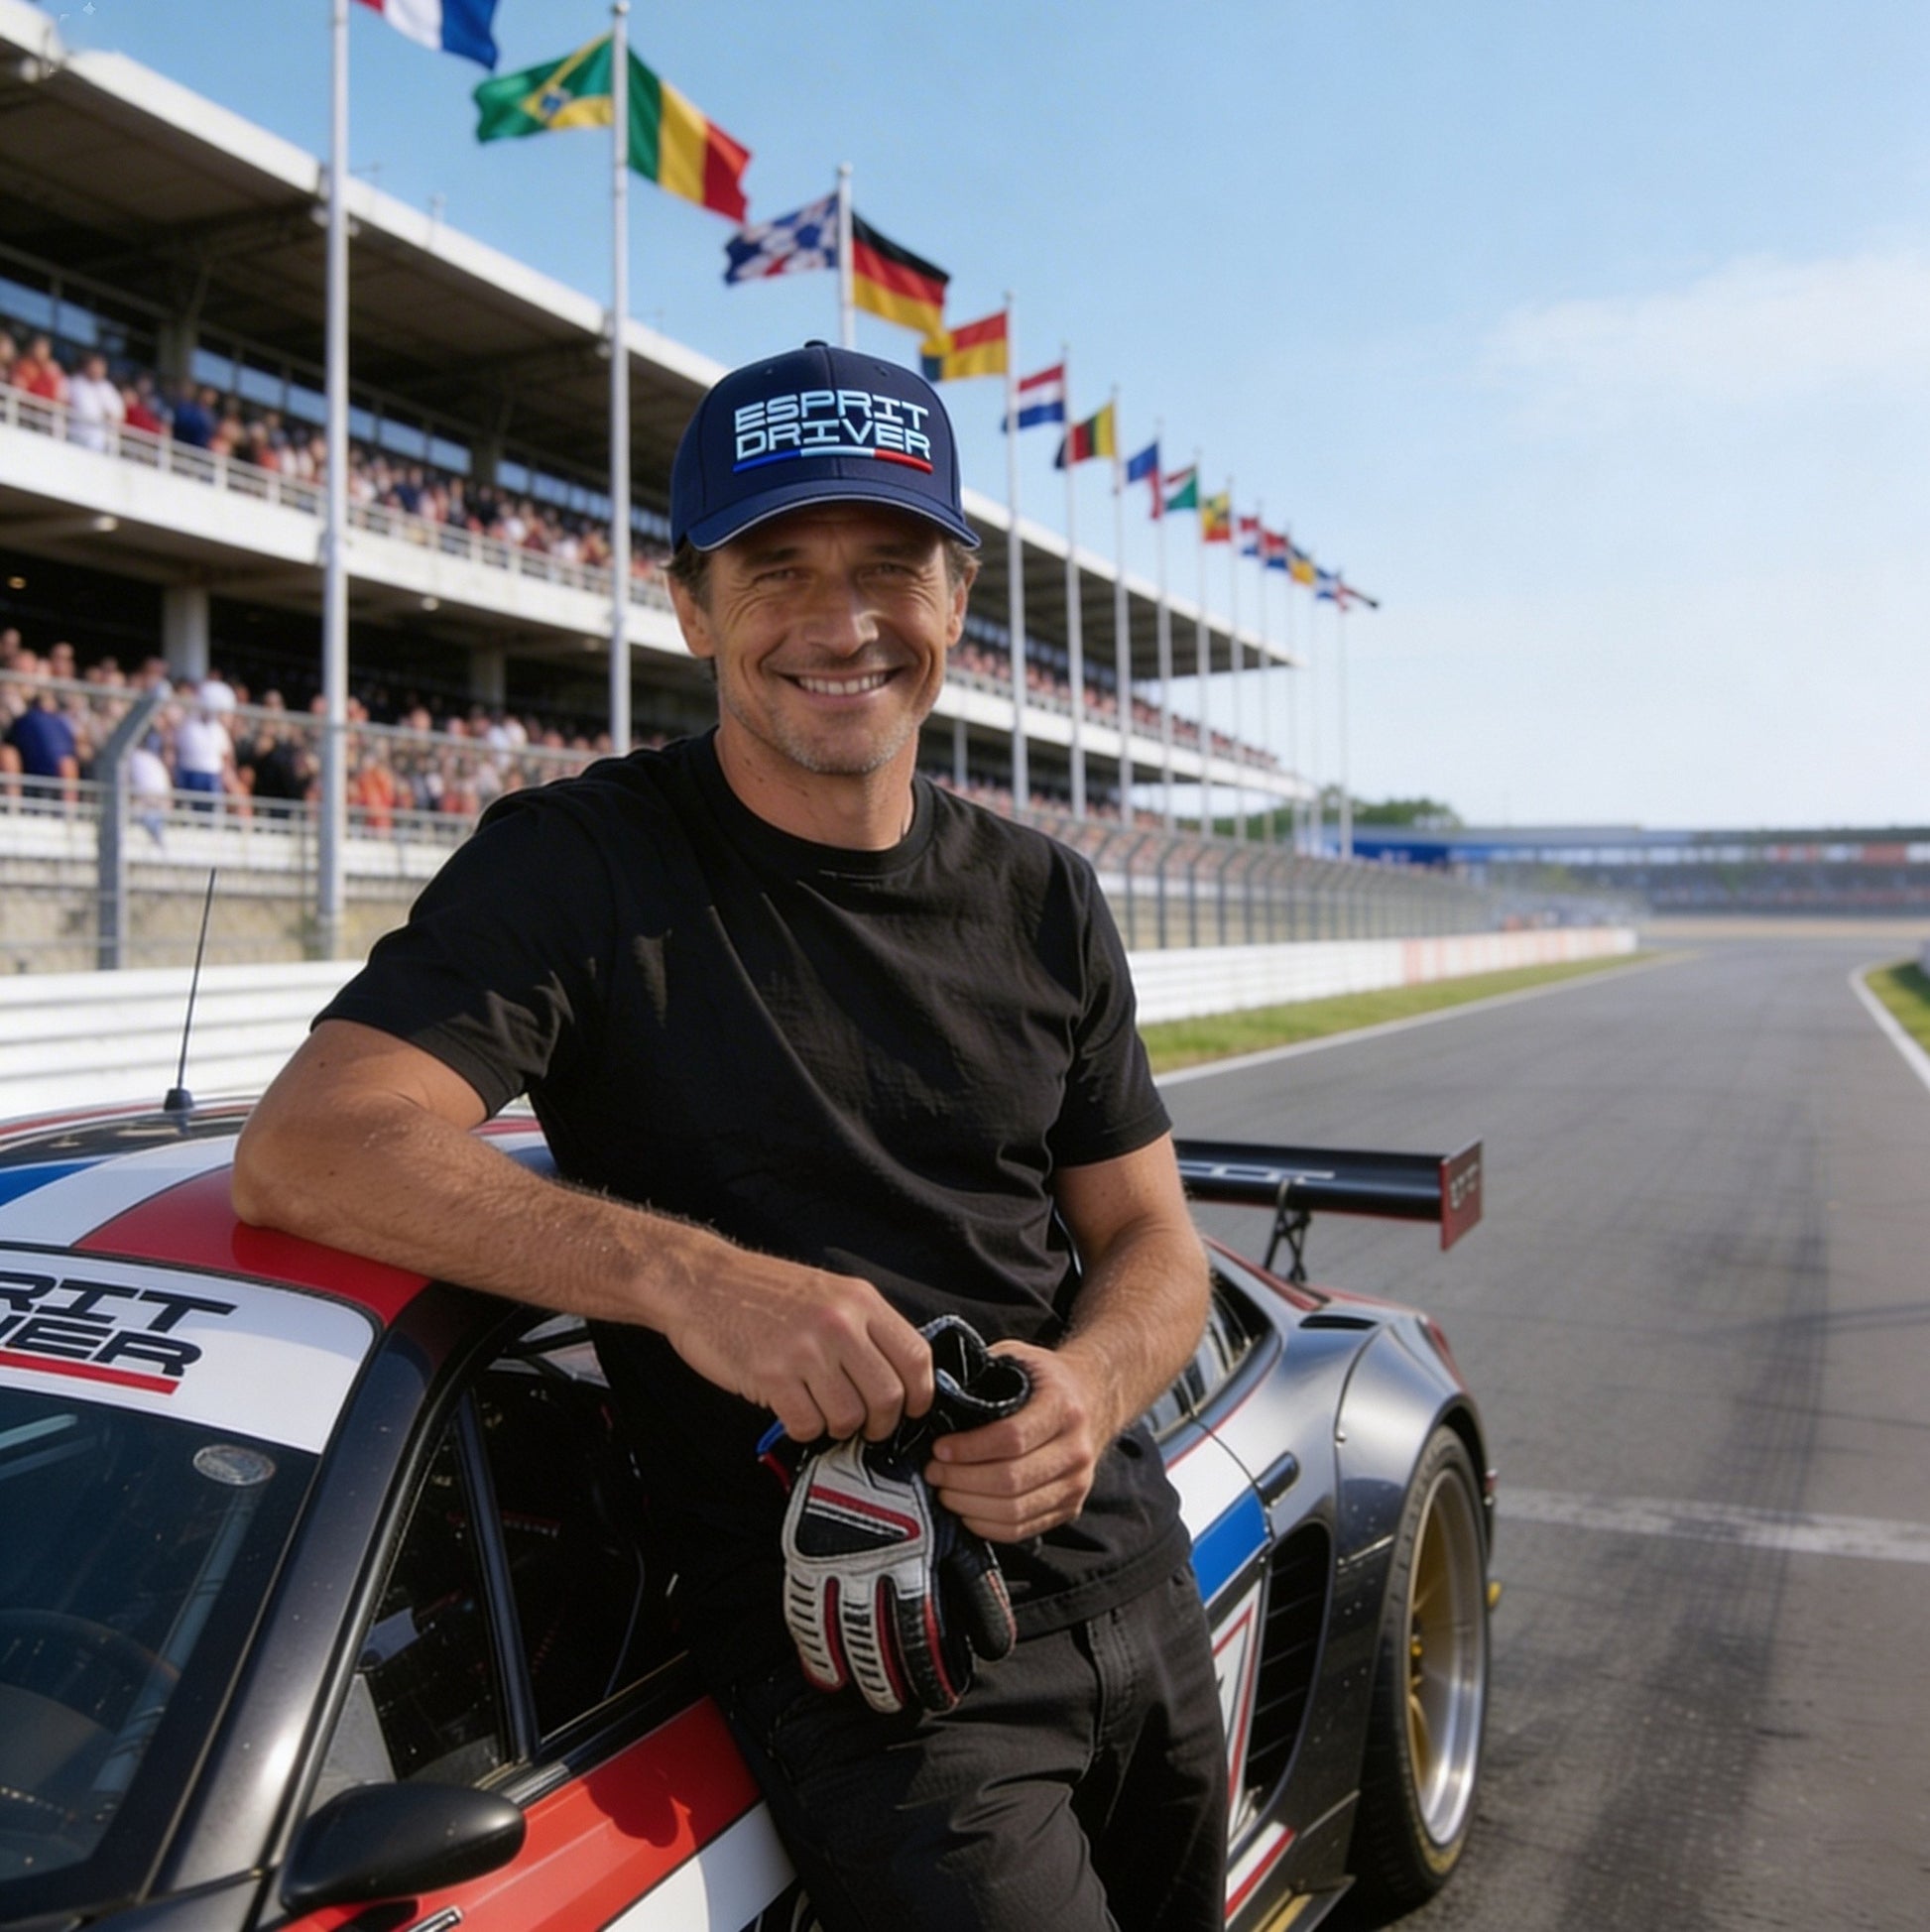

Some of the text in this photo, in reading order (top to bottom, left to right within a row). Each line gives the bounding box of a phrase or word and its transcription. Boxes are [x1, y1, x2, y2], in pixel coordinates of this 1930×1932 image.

[734, 389, 929, 432] ESPRIT
[736, 419, 931, 460] DRIVER
[0, 1314, 202, 1378] ER
